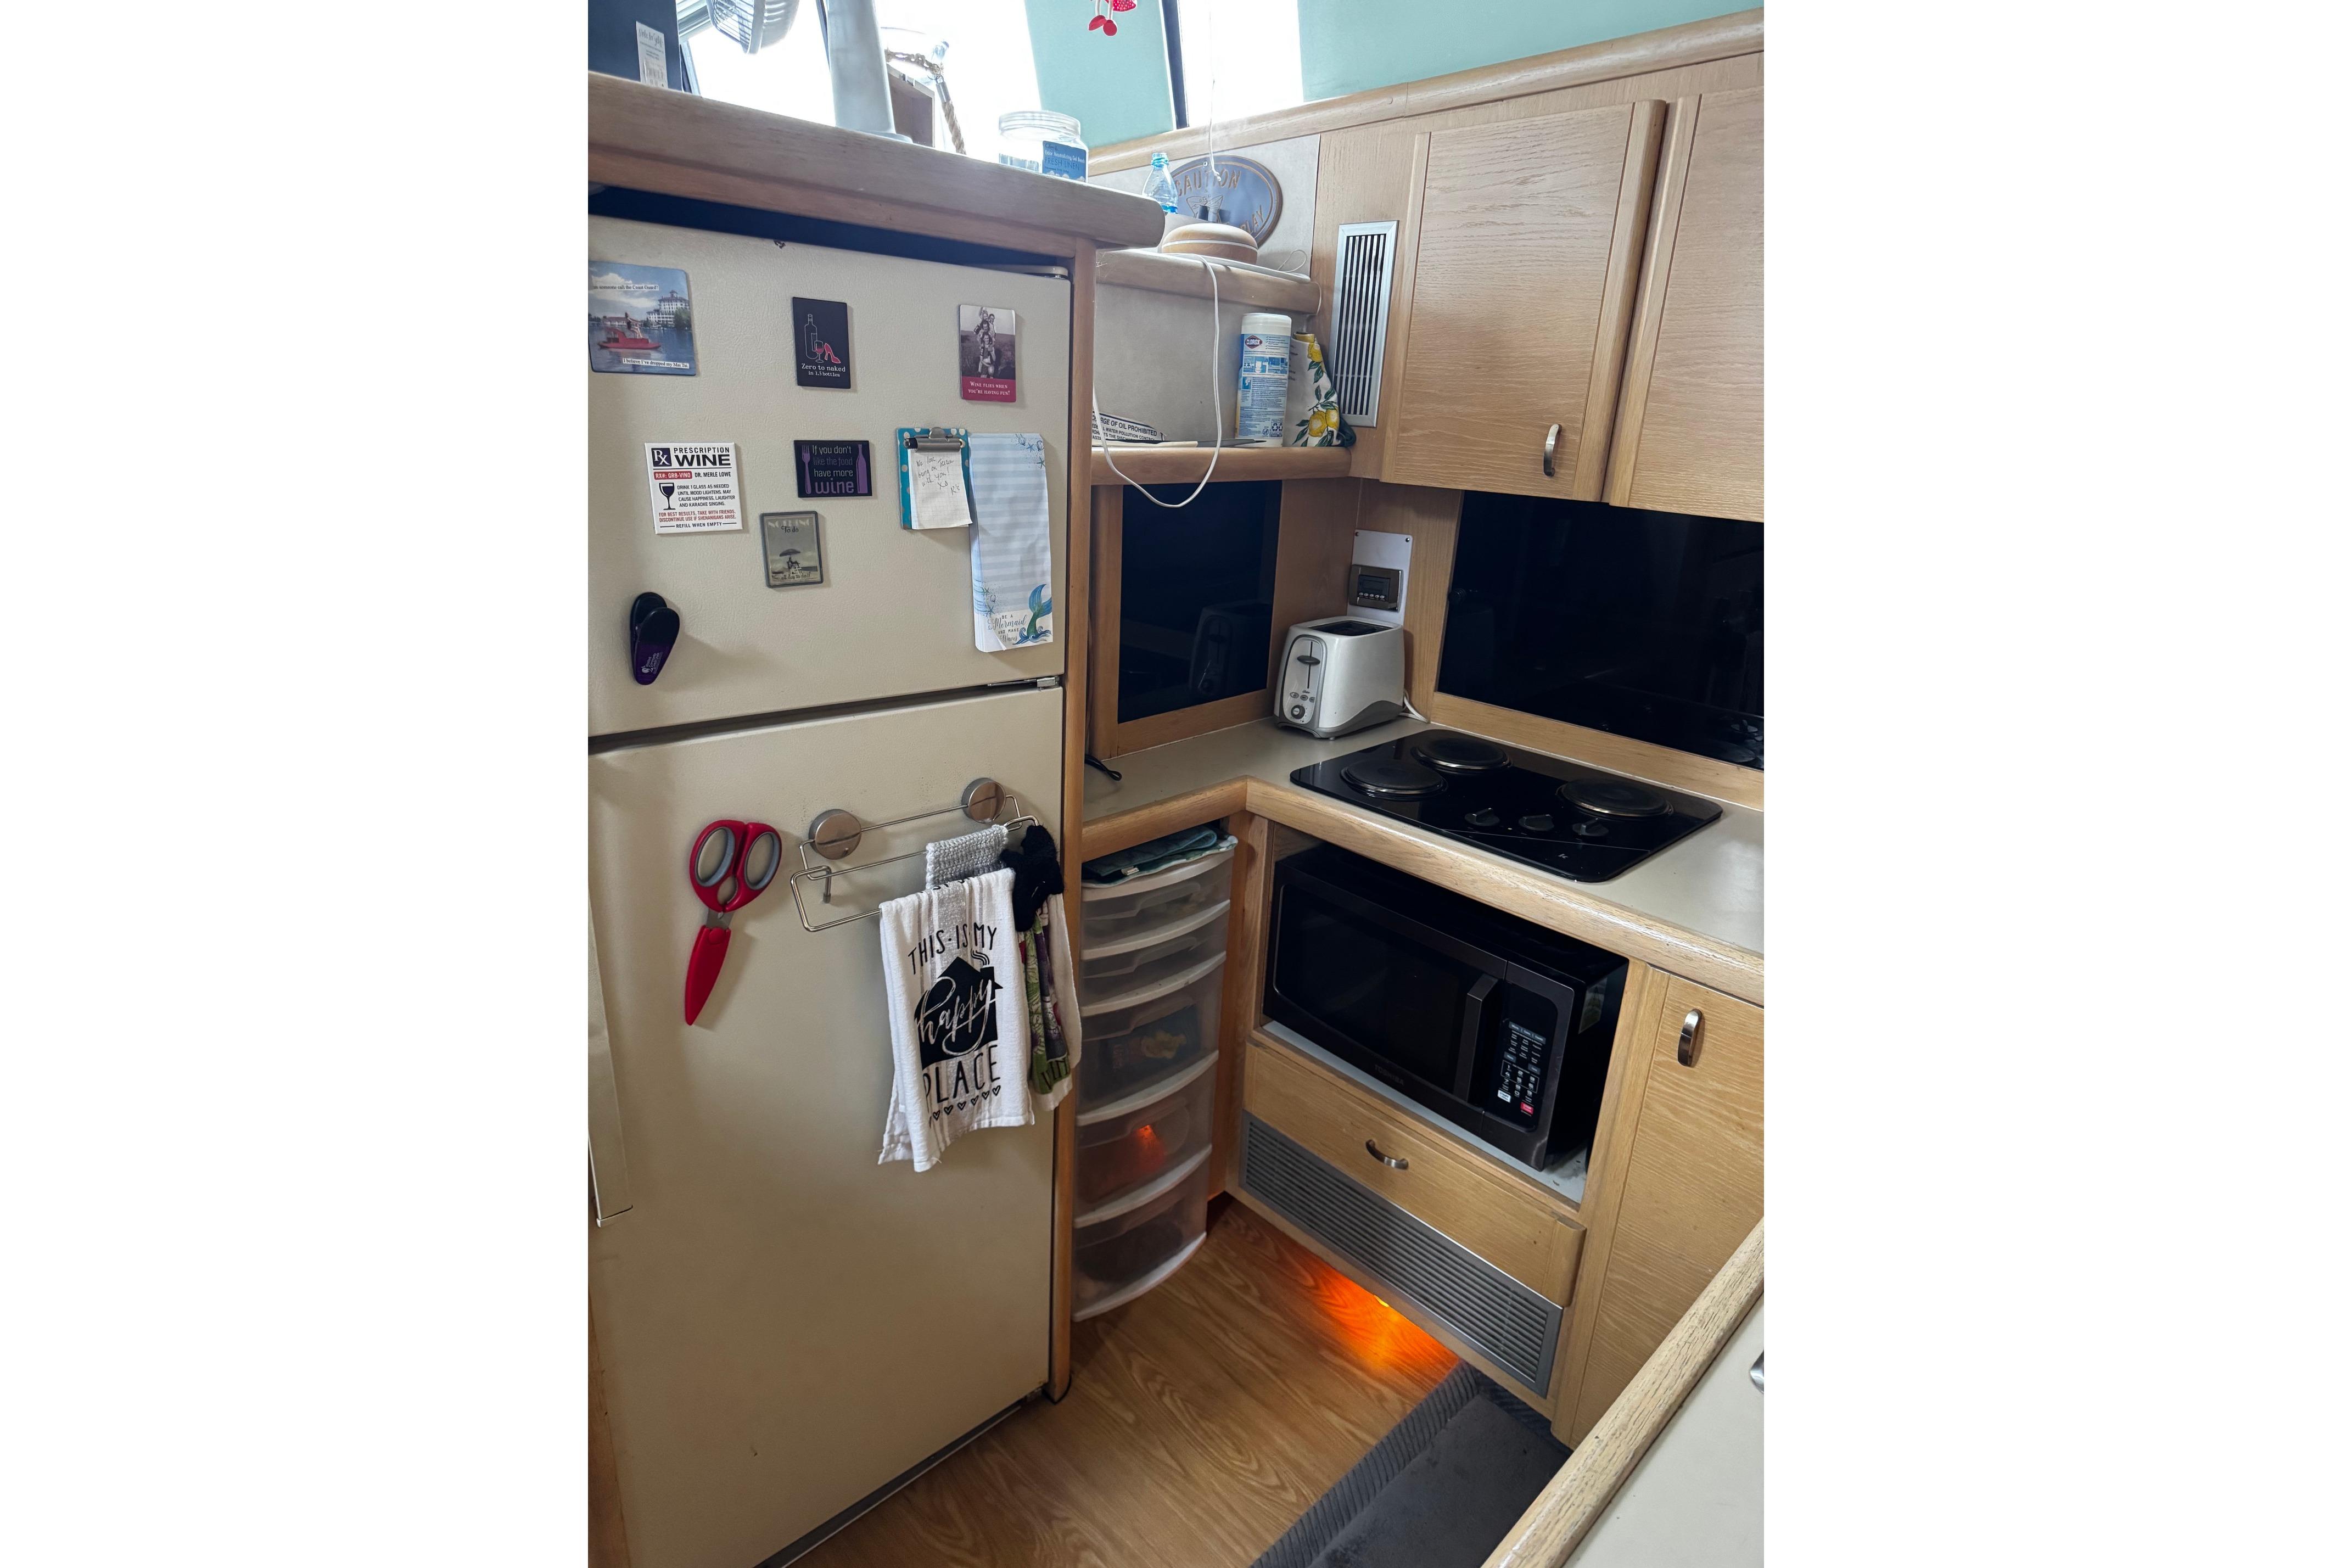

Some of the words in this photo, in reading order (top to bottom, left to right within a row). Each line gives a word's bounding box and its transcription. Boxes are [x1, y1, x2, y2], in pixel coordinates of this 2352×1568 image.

[1045, 157, 1062, 166] FRESH
[1065, 161, 1080, 171] LINEN
[1128, 424, 1157, 436] PROHIBITED
[812, 445, 817, 455] If
[819, 446, 832, 455] you
[834, 445, 852, 455] don't
[674, 454, 731, 467] WINE
[813, 457, 825, 466] like
[826, 457, 837, 466] the
[838, 457, 853, 467] food
[814, 468, 831, 477] have
[815, 478, 854, 494] wine
[991, 614, 1027, 630] Mermaid
[908, 929, 945, 975] THIS
[956, 923, 968, 950] IS
[973, 922, 997, 950] MY
[915, 976, 997, 1056] happy
[922, 1044, 1001, 1115] PLACE
